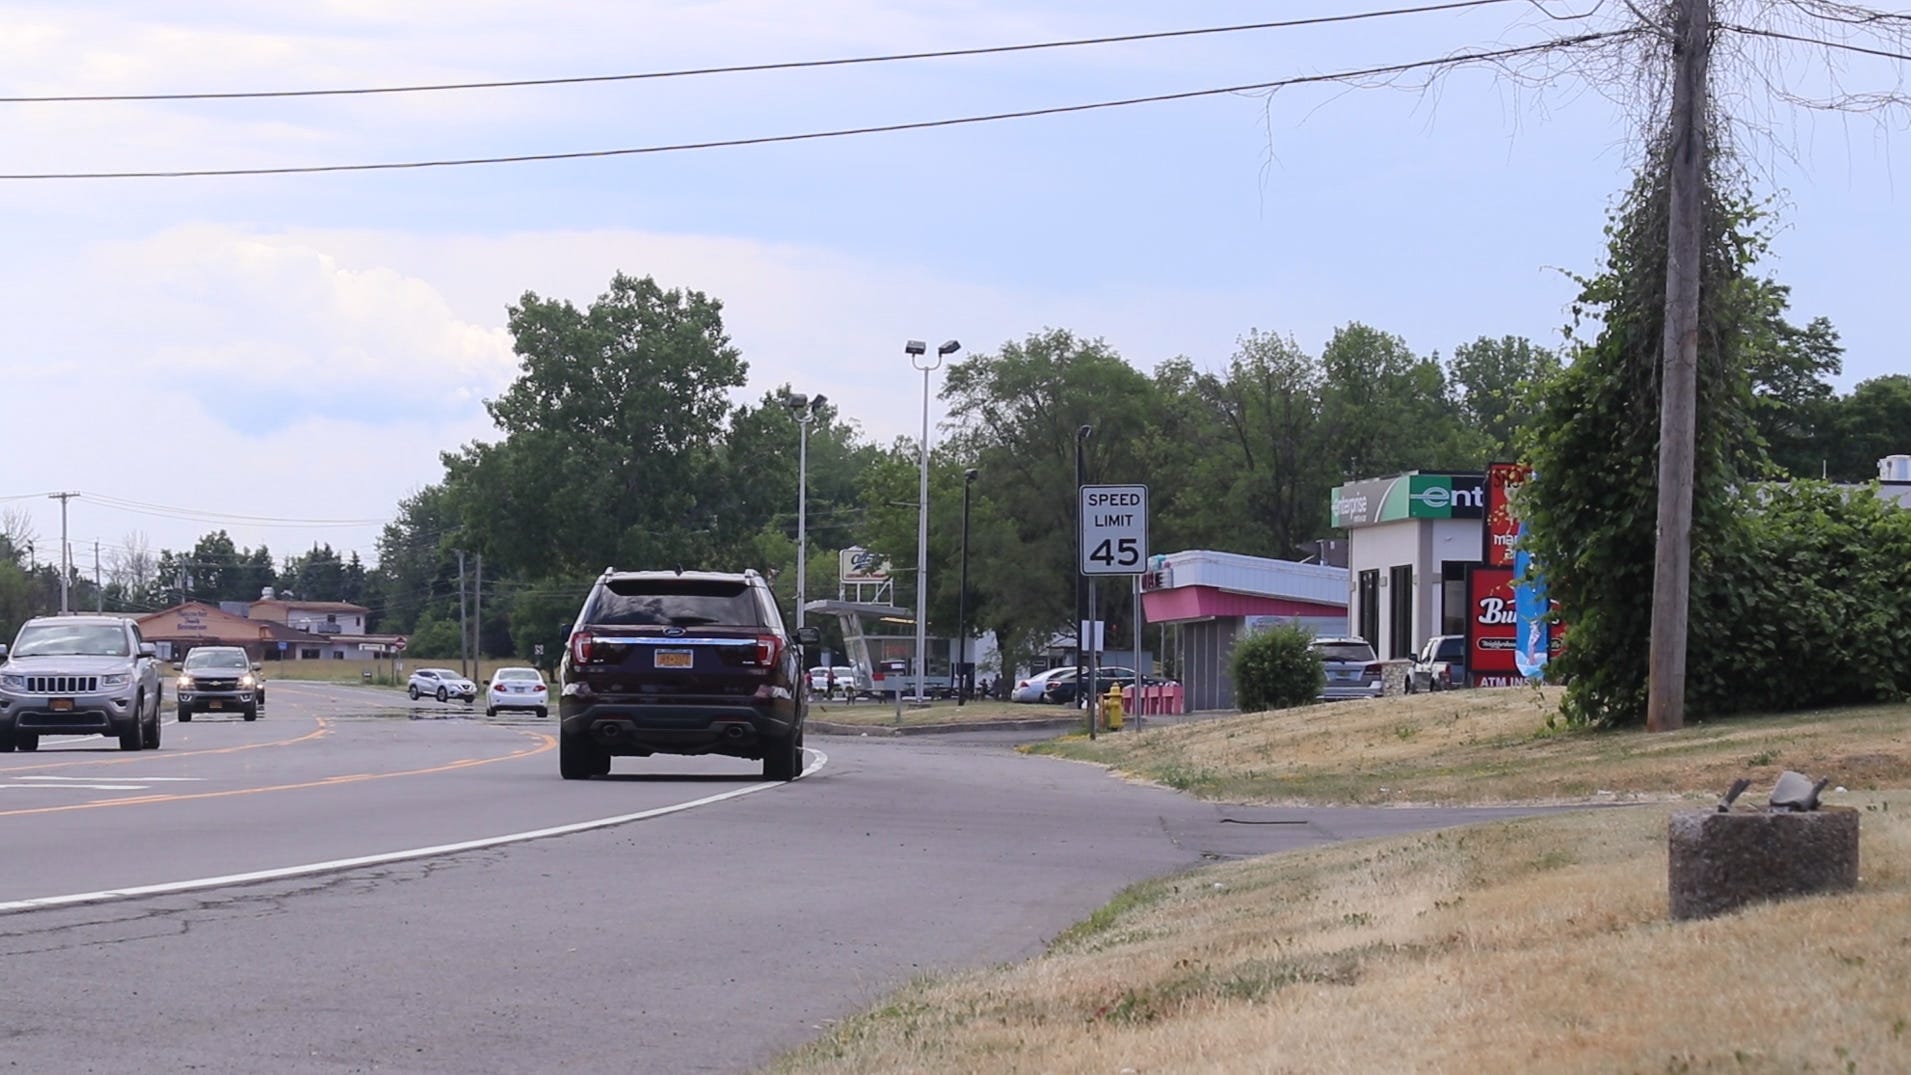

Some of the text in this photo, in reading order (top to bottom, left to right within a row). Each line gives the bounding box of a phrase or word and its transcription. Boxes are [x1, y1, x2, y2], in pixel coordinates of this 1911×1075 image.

[1088, 493, 1140, 506] SPEED
[1332, 492, 1367, 519] enterprise
[1411, 486, 1483, 508] ent
[1094, 514, 1134, 527] LIMIT
[1089, 538, 1139, 566] 45
[1478, 597, 1517, 624] Bu
[1480, 677, 1506, 687] ATM
